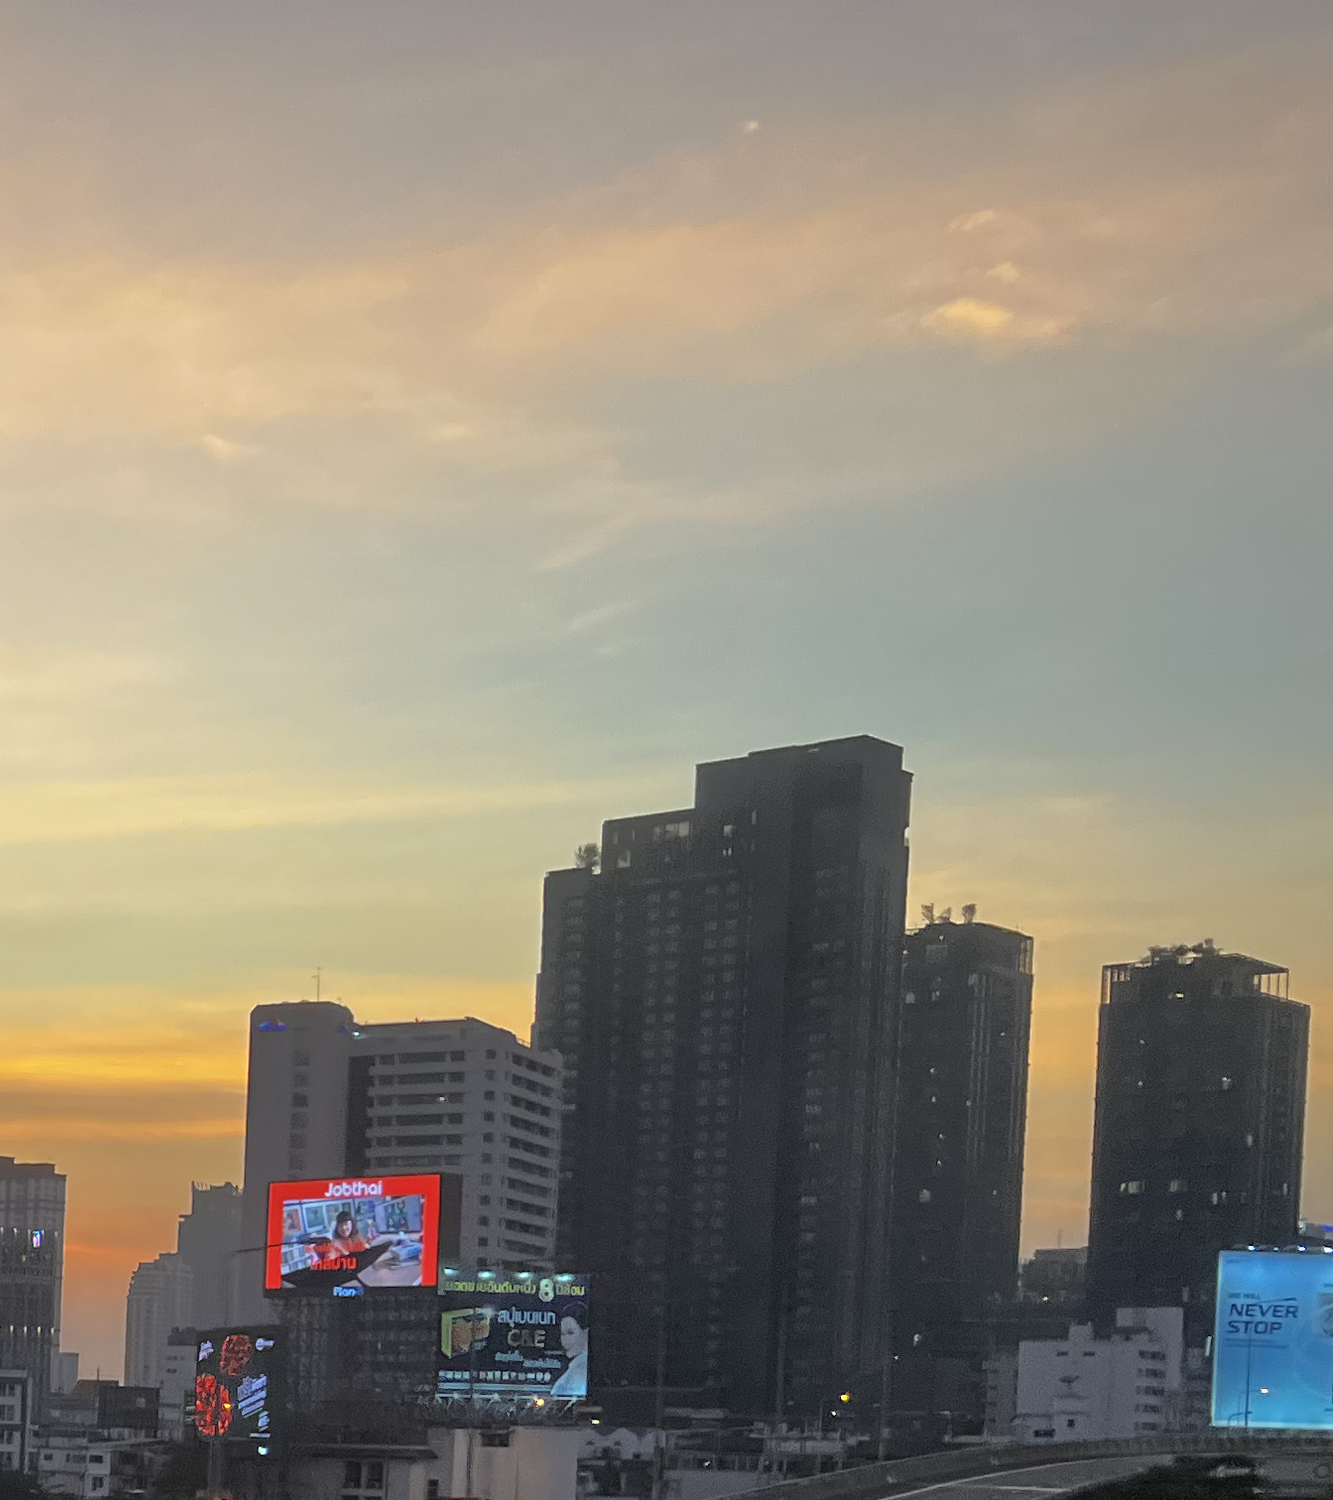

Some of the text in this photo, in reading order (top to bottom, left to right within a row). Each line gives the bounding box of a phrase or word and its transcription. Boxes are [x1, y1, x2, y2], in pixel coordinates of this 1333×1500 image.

[538, 1278, 555, 1302] 8
[1230, 1303, 1299, 1319] NEVER
[1227, 1320, 1283, 1335] STOP
